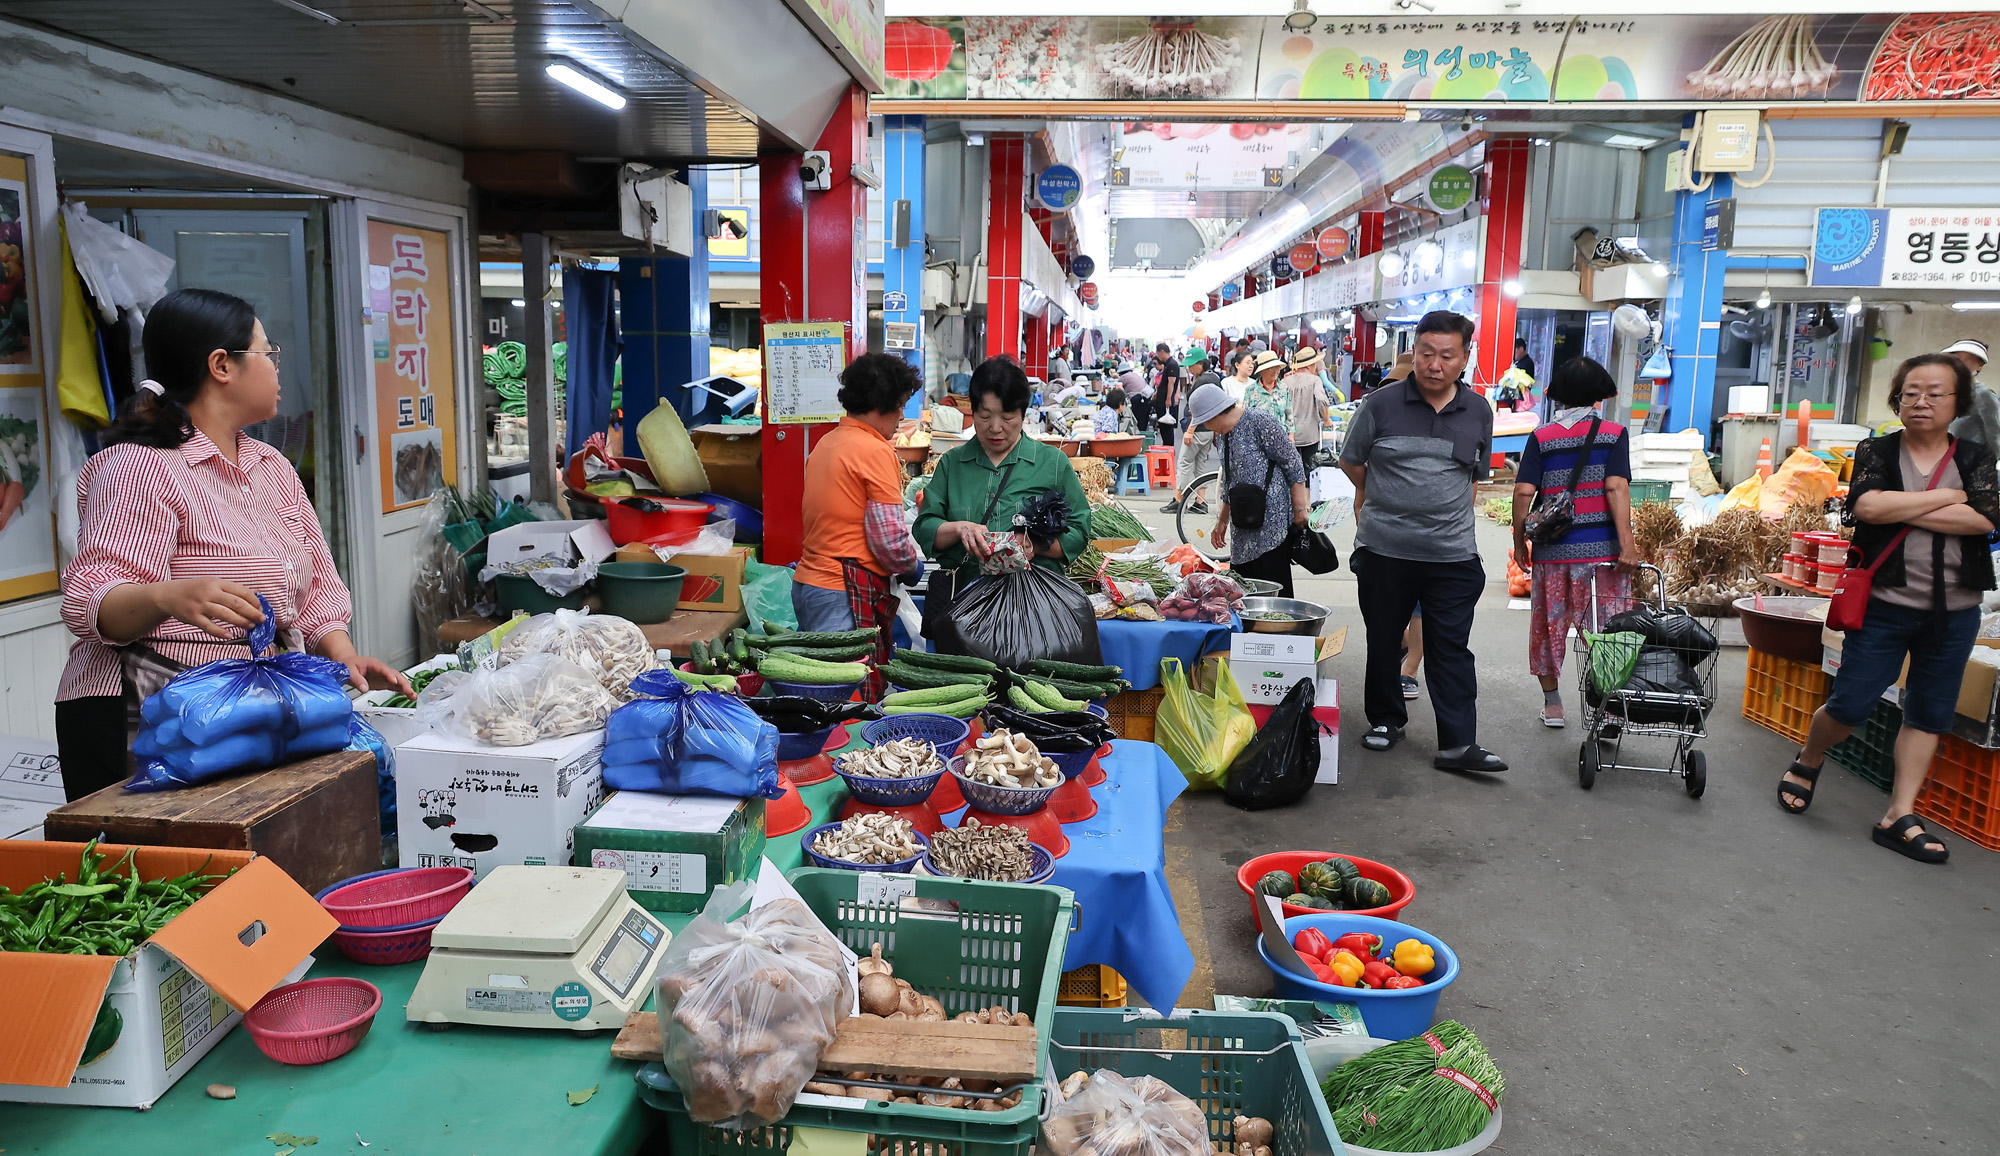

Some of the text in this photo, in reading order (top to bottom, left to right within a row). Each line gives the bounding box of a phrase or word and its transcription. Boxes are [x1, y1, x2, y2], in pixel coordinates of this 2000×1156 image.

[1324, 23, 1444, 35] 공설전통시장에
[1455, 21, 1521, 34] 오신것을
[1532, 20, 1636, 33] 환영합니다!
[1342, 62, 1390, 83] 특산물
[1402, 45, 1532, 85] 의성마늘
[1953, 217, 1970, 227] 각종
[1974, 217, 1992, 227] 어물
[1831, 218, 1881, 272] MARINE PRODUCTS
[1952, 273, 1965, 282] HP
[392, 238, 429, 388] 도라지
[891, 301, 899, 310] 7
[397, 394, 434, 427] 도매
[447, 776, 540, 794] 대경버섯농장
[649, 865, 659, 878] 6
[597, 955, 607, 967] CAS
[474, 990, 498, 999] CAS
